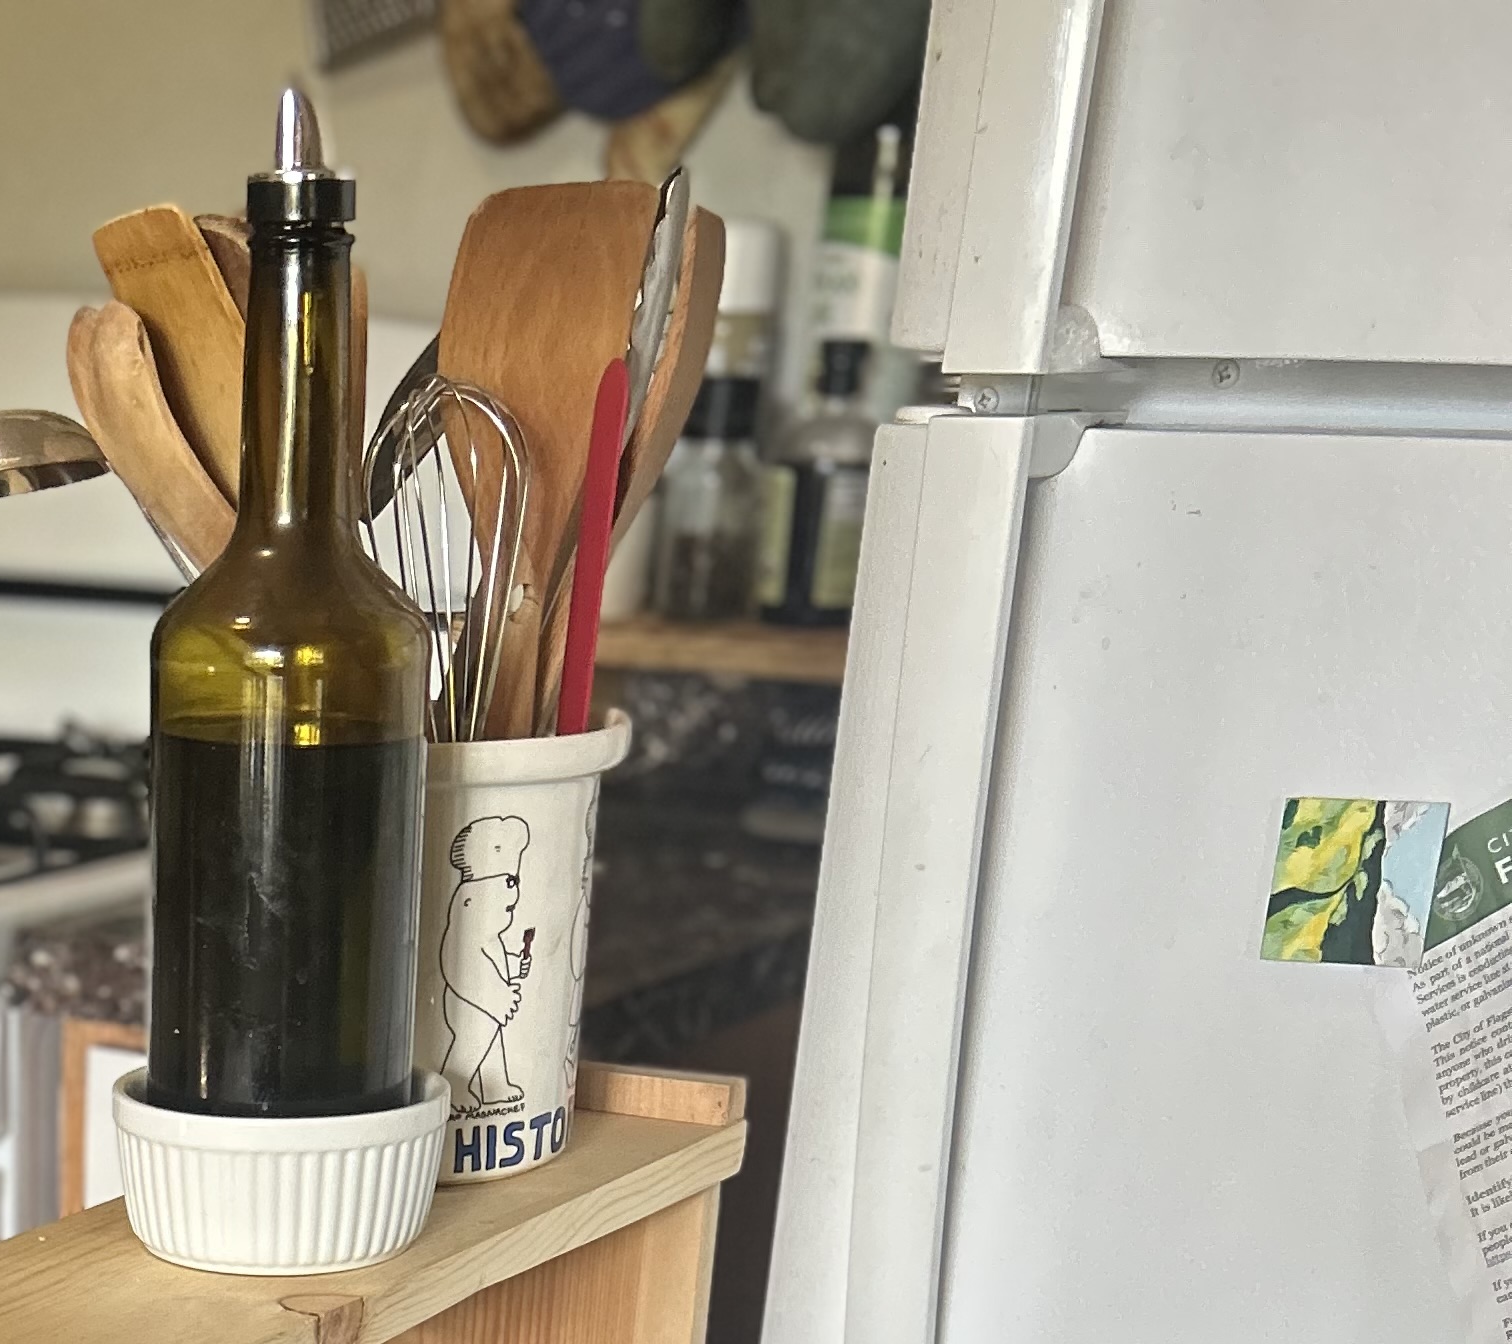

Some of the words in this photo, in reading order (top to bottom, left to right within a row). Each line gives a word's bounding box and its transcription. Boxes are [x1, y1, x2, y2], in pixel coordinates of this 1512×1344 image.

[1407, 955, 1444, 979] Notice
[1445, 945, 1456, 959] of
[1458, 920, 1507, 952] unknown
[1413, 981, 1427, 993] As
[1430, 967, 1449, 986] part
[1452, 957, 1462, 971] of
[1474, 931, 1509, 959] national
[1416, 979, 1456, 1004] Services
[1456, 973, 1466, 983] is
[1421, 998, 1448, 1016] water
[1451, 981, 1482, 1002] service
[1483, 970, 1501, 984] line
[1426, 1009, 1460, 1032] plastic,
[1461, 1001, 1471, 1012] or
[1431, 1042, 1450, 1055] The
[1453, 1030, 1470, 1044] City
[1473, 1020, 1483, 1033] of
[1433, 1053, 1455, 1067] This
[1459, 1036, 1487, 1056] notice
[1436, 1058, 1470, 1080] anyone
[1474, 1046, 1493, 1060] who
[1438, 1067, 1482, 1095] property,
[1484, 1056, 1502, 1070] this
[1441, 1095, 1454, 1105] by
[1458, 1072, 1499, 1098] childcare
[1446, 1097, 1479, 1118] service
[1480, 1084, 1502, 1101] line)
[453, 1106, 566, 1173] HISTO
[1454, 1120, 1492, 1143] Because
[1454, 1135, 1481, 1154] could
[1484, 1130, 1495, 1140] be
[1455, 1150, 1477, 1167] lead
[1480, 1145, 1490, 1155] or
[1459, 1164, 1484, 1180] from
[1484, 1151, 1508, 1168] their
[1470, 1207, 1480, 1217] It
[1481, 1204, 1490, 1213] is
[1477, 1230, 1486, 1242] If
[1488, 1225, 1508, 1240] you
[1492, 1279, 1502, 1292] If
